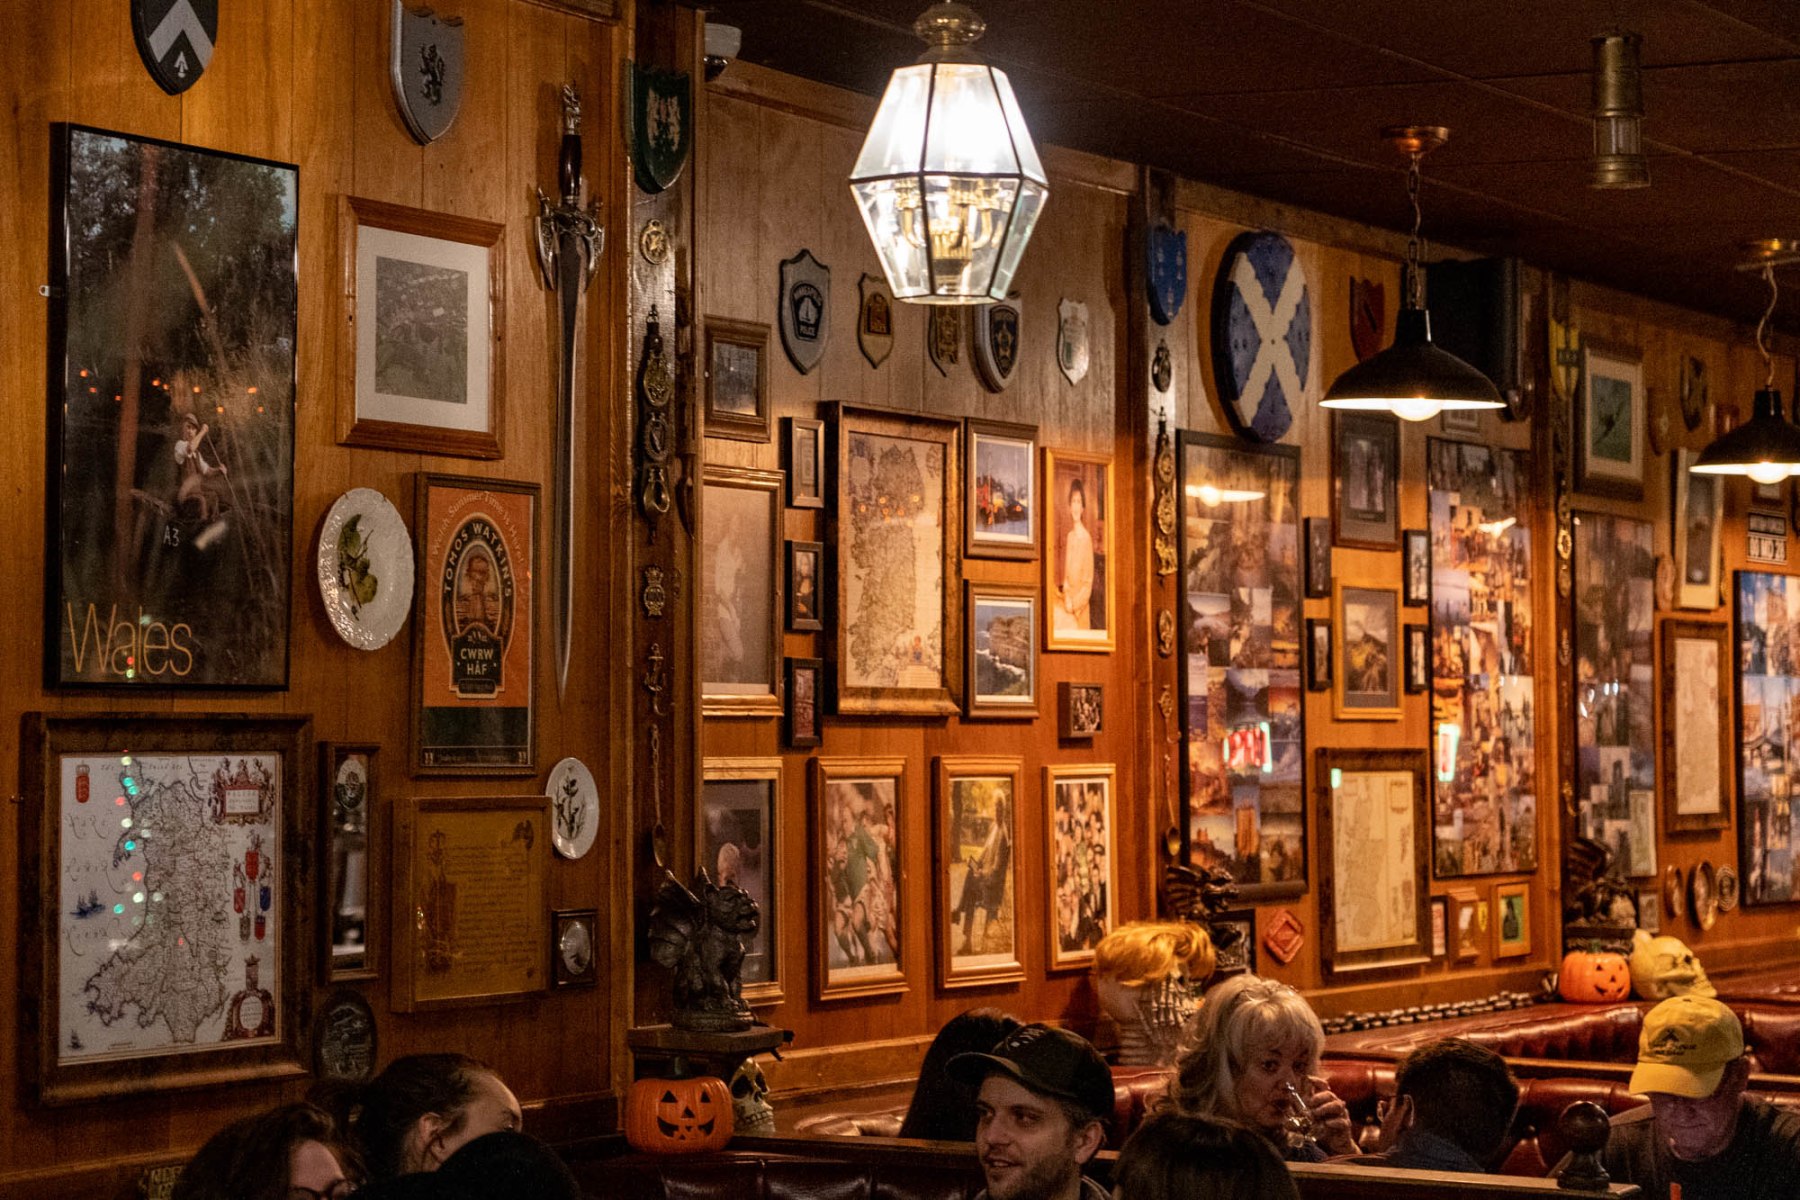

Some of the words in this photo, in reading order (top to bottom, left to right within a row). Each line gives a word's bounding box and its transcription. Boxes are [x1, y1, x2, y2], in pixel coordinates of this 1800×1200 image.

[447, 492, 482, 517] Summer
[484, 490, 505, 515] Time
[163, 525, 179, 547] A3
[444, 529, 468, 594] TOMOS
[472, 522, 512, 597] WATKIN'S
[67, 602, 193, 676] Wales
[460, 647, 494, 660] CWRW
